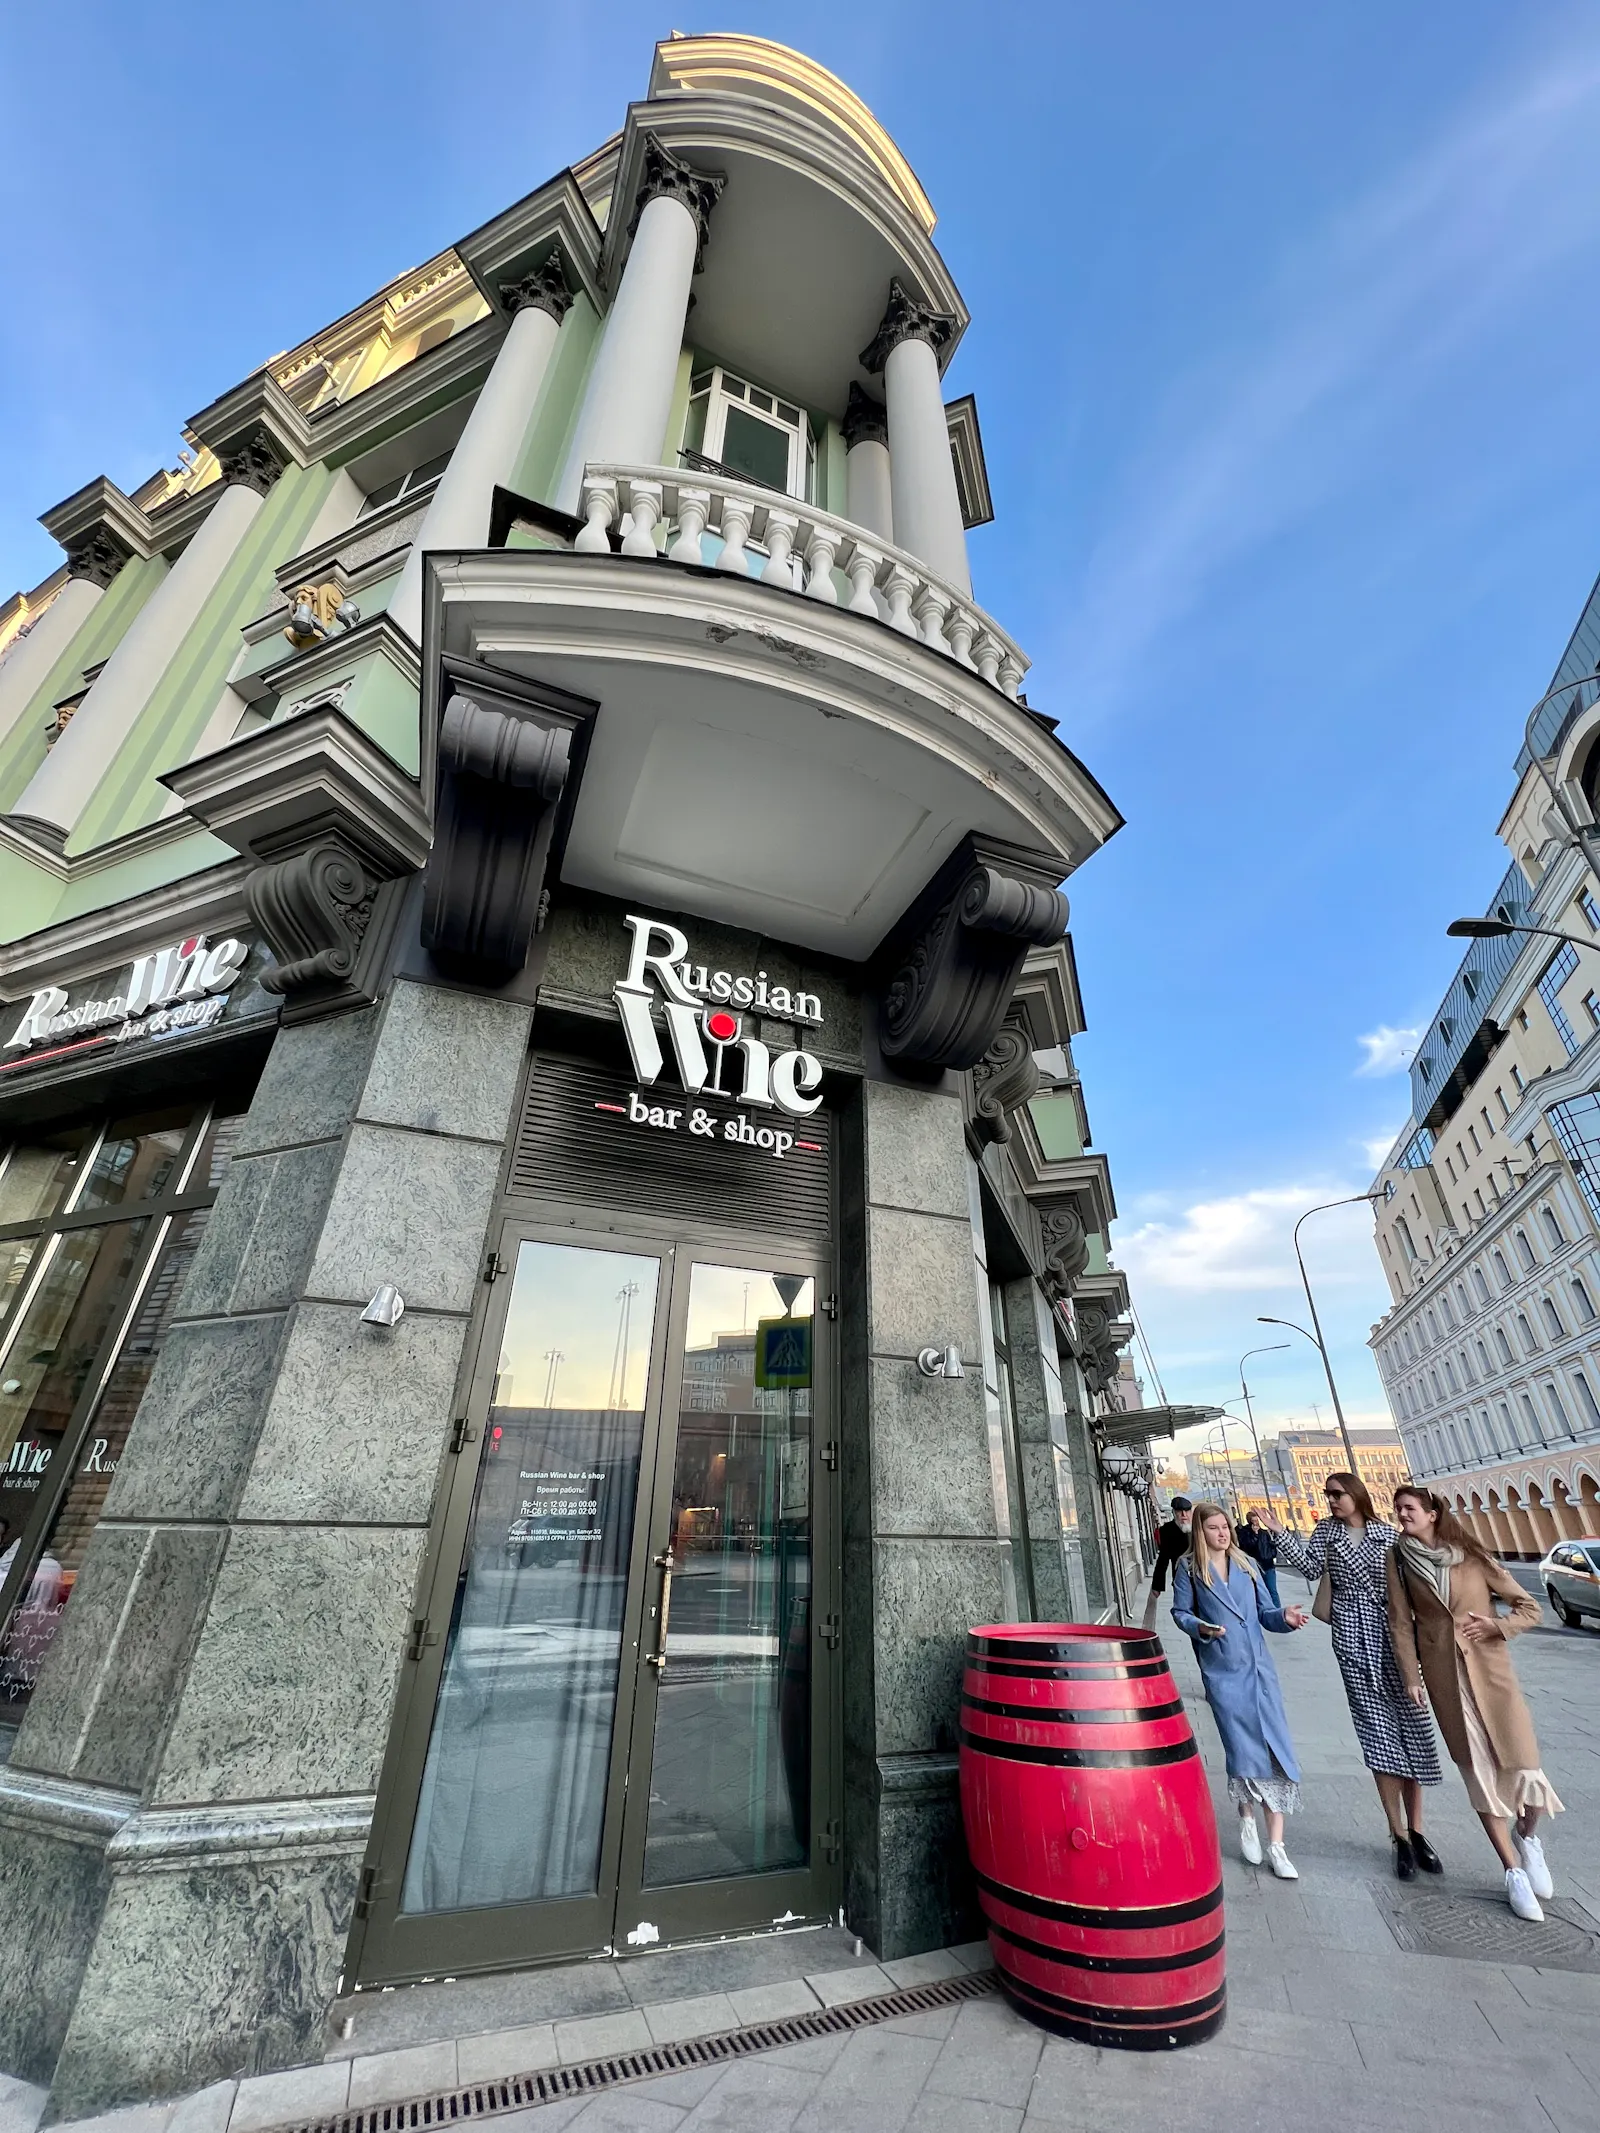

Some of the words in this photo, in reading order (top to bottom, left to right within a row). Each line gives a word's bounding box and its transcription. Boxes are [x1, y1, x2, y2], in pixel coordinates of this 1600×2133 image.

[124, 934, 249, 1016] Wine
[613, 914, 825, 1028] Russian
[149, 1009, 172, 1032] &
[611, 990, 825, 1118] Wine
[628, 1092, 682, 1130] bar
[688, 1107, 718, 1138] &
[724, 1114, 794, 1158] shop
[520, 1471, 549, 1479] Russian
[549, 1471, 567, 1479] Wine
[568, 1471, 581, 1480] bar
[580, 1472, 588, 1480] &
[588, 1472, 606, 1481] shop
[536, 1485, 559, 1494] Время
[568, 1501, 578, 1509] до
[568, 1508, 578, 1516] до
